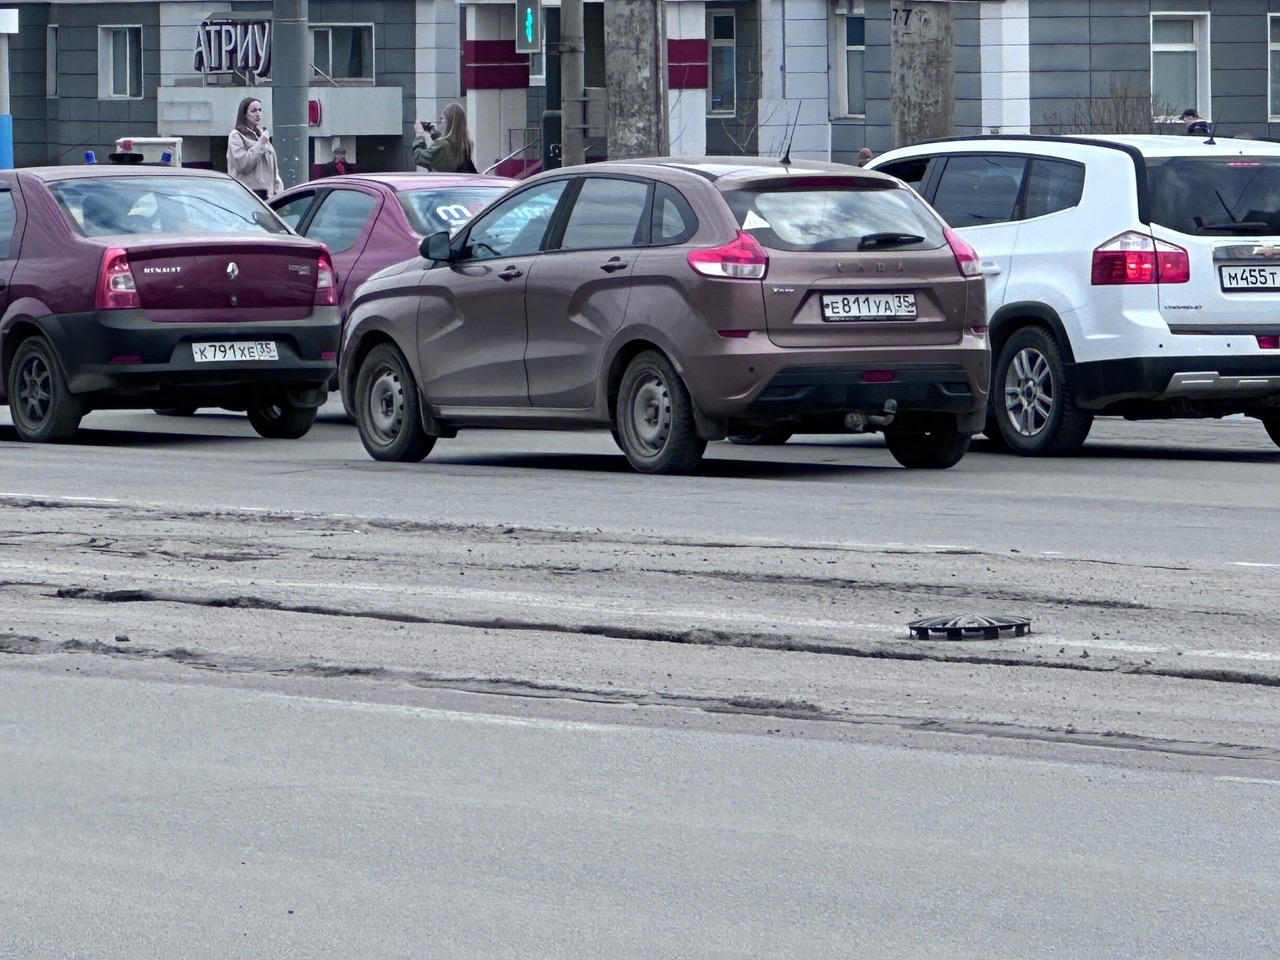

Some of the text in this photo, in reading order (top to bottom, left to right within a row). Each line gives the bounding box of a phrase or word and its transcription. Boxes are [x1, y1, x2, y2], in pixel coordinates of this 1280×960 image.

[193, 20, 271, 78] АТРИУ
[1228, 269, 1278, 286] М455Т
[894, 295, 910, 309] 35
[257, 342, 272, 355] 35
